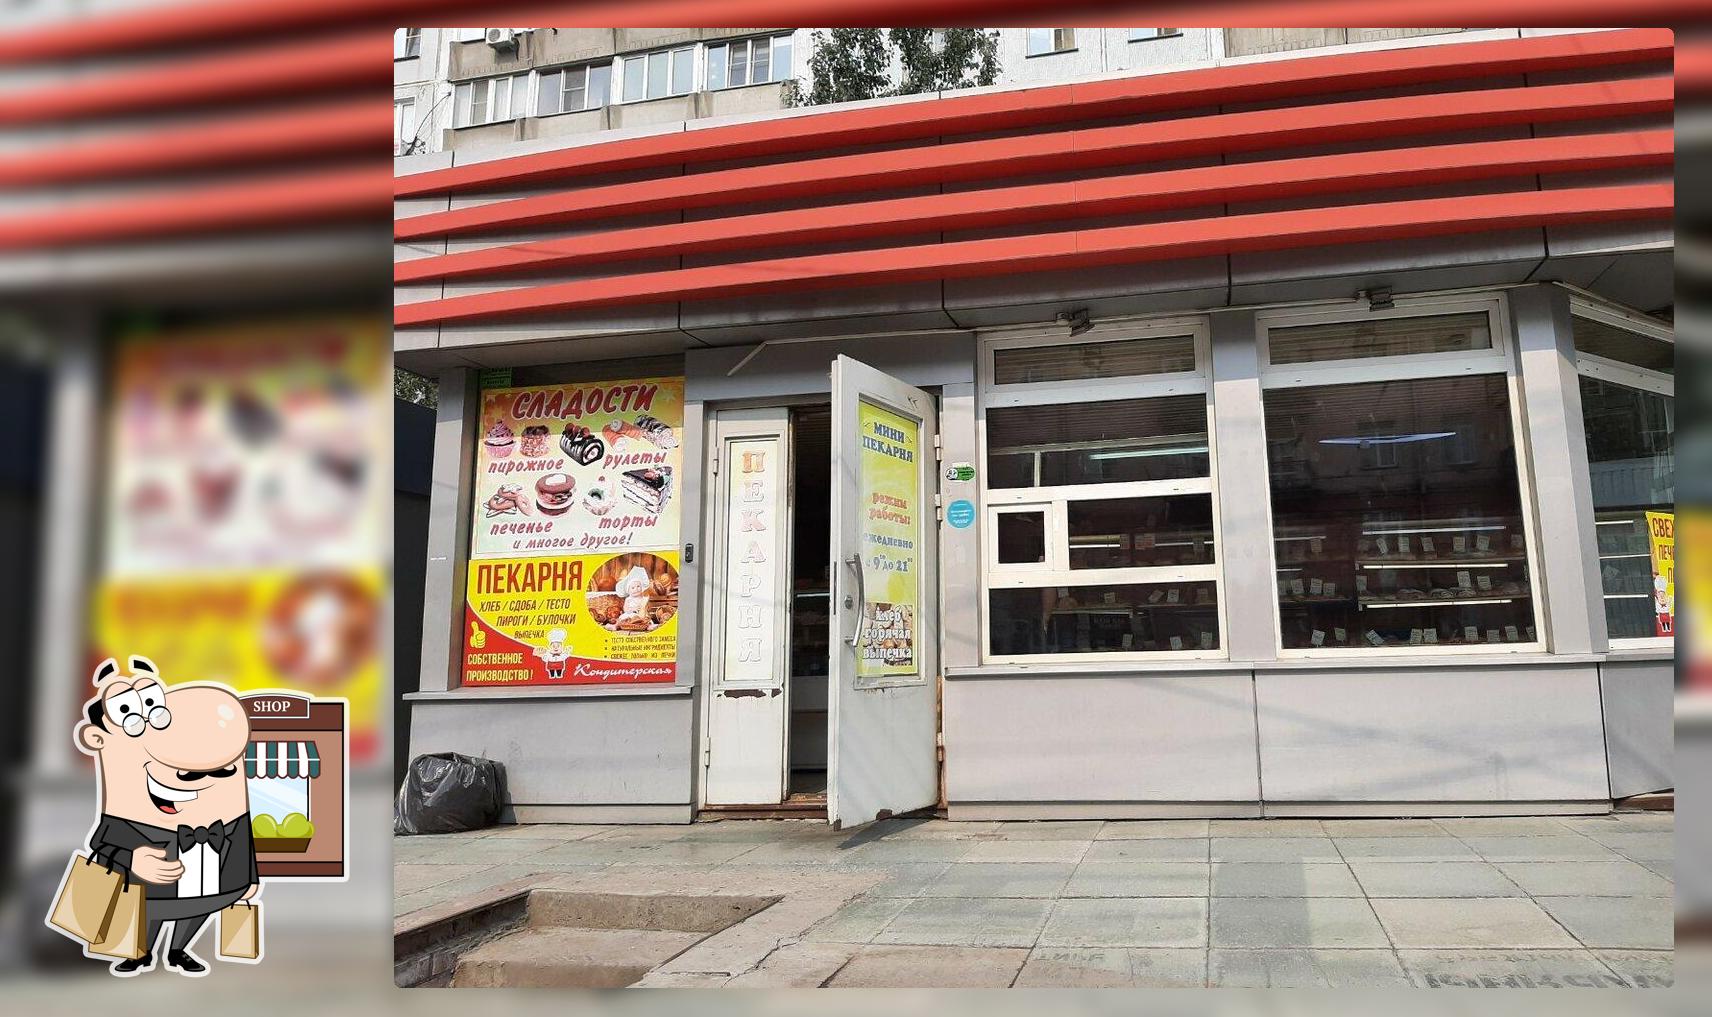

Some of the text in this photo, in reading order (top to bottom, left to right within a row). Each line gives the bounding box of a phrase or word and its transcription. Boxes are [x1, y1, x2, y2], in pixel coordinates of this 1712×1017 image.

[513, 386, 657, 419] СЛАДОСТИ
[874, 422, 904, 443] МИНИ
[863, 436, 912, 462] ПЕКАРНЯ
[488, 459, 564, 473] пирожное
[603, 452, 666, 469] рулеты
[490, 521, 553, 535] печенье
[598, 515, 657, 530] торты
[513, 532, 633, 549] и многое другое!
[1659, 545, 1674, 560] ПЕЧ
[477, 561, 583, 593] ПЕКАРНЯ
[479, 600, 501, 612] ХЛЕБ
[509, 600, 537, 611] СДОБА
[546, 599, 571, 610] ТЕСТО
[496, 616, 529, 627] ПИРОГИ
[537, 614, 577, 626] БУЛОЧКИ
[468, 653, 523, 665] СОБСТВЕННОЕ
[574, 663, 672, 680] Кондитерская
